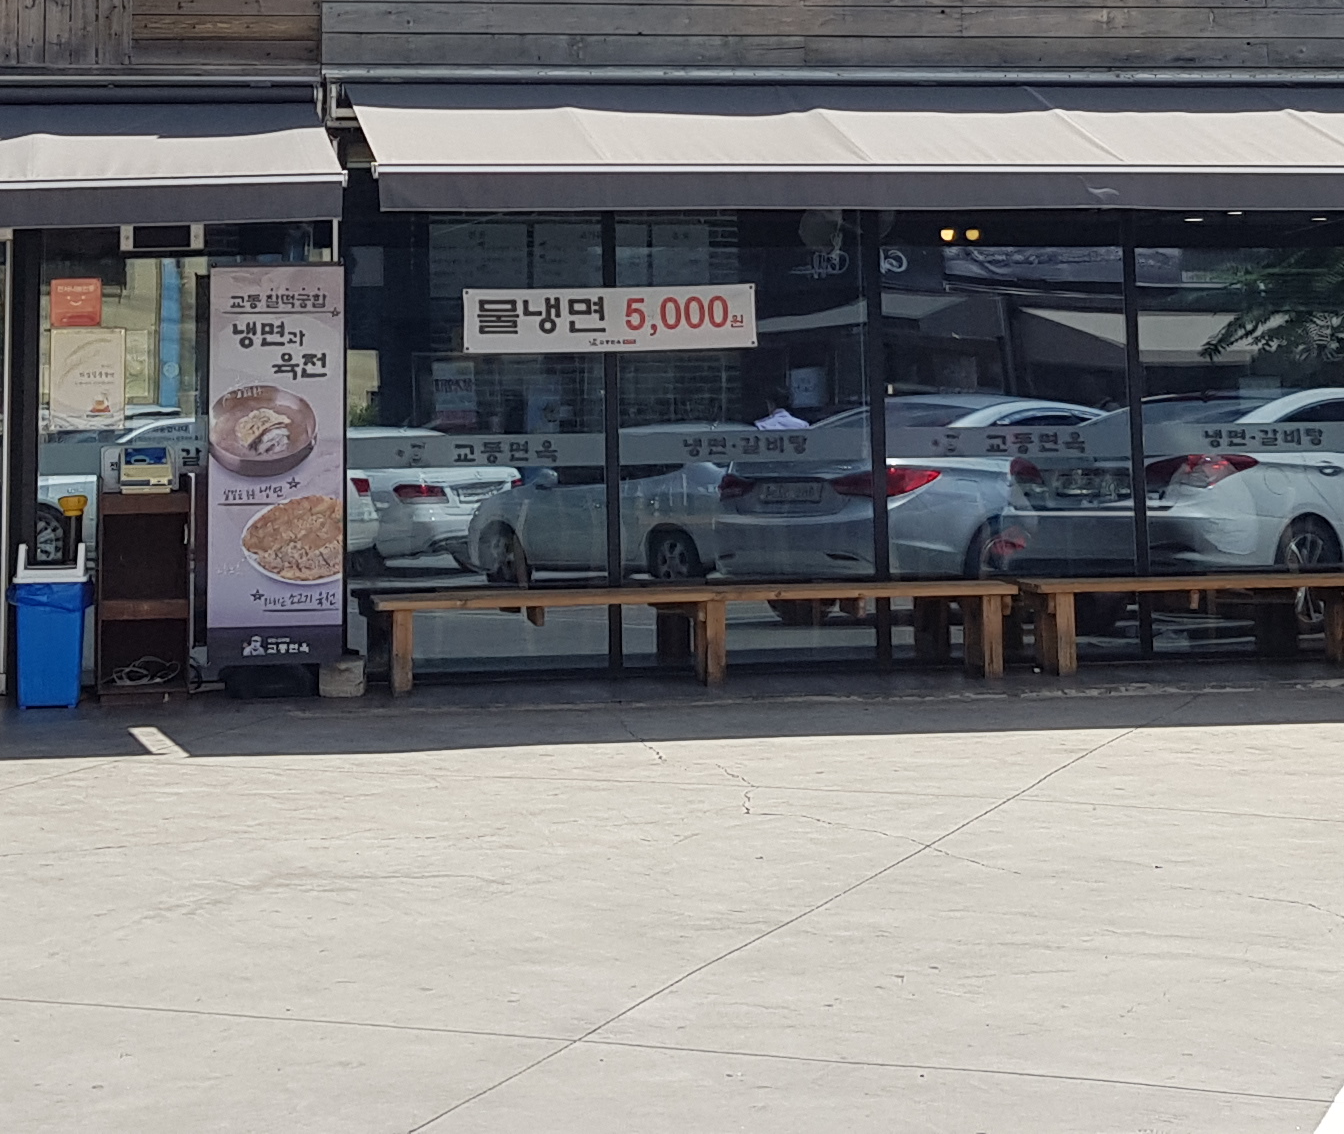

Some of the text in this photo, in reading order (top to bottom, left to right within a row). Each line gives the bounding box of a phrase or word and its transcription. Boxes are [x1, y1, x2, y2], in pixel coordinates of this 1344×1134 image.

[230, 292, 327, 309] 교동 찰떡궁합
[477, 295, 744, 336] 물냉면 5,000원
[232, 321, 305, 349] 냉면과
[271, 352, 328, 380] 육전
[453, 439, 559, 464] 교동면옥
[986, 432, 1086, 454] 교동면옥
